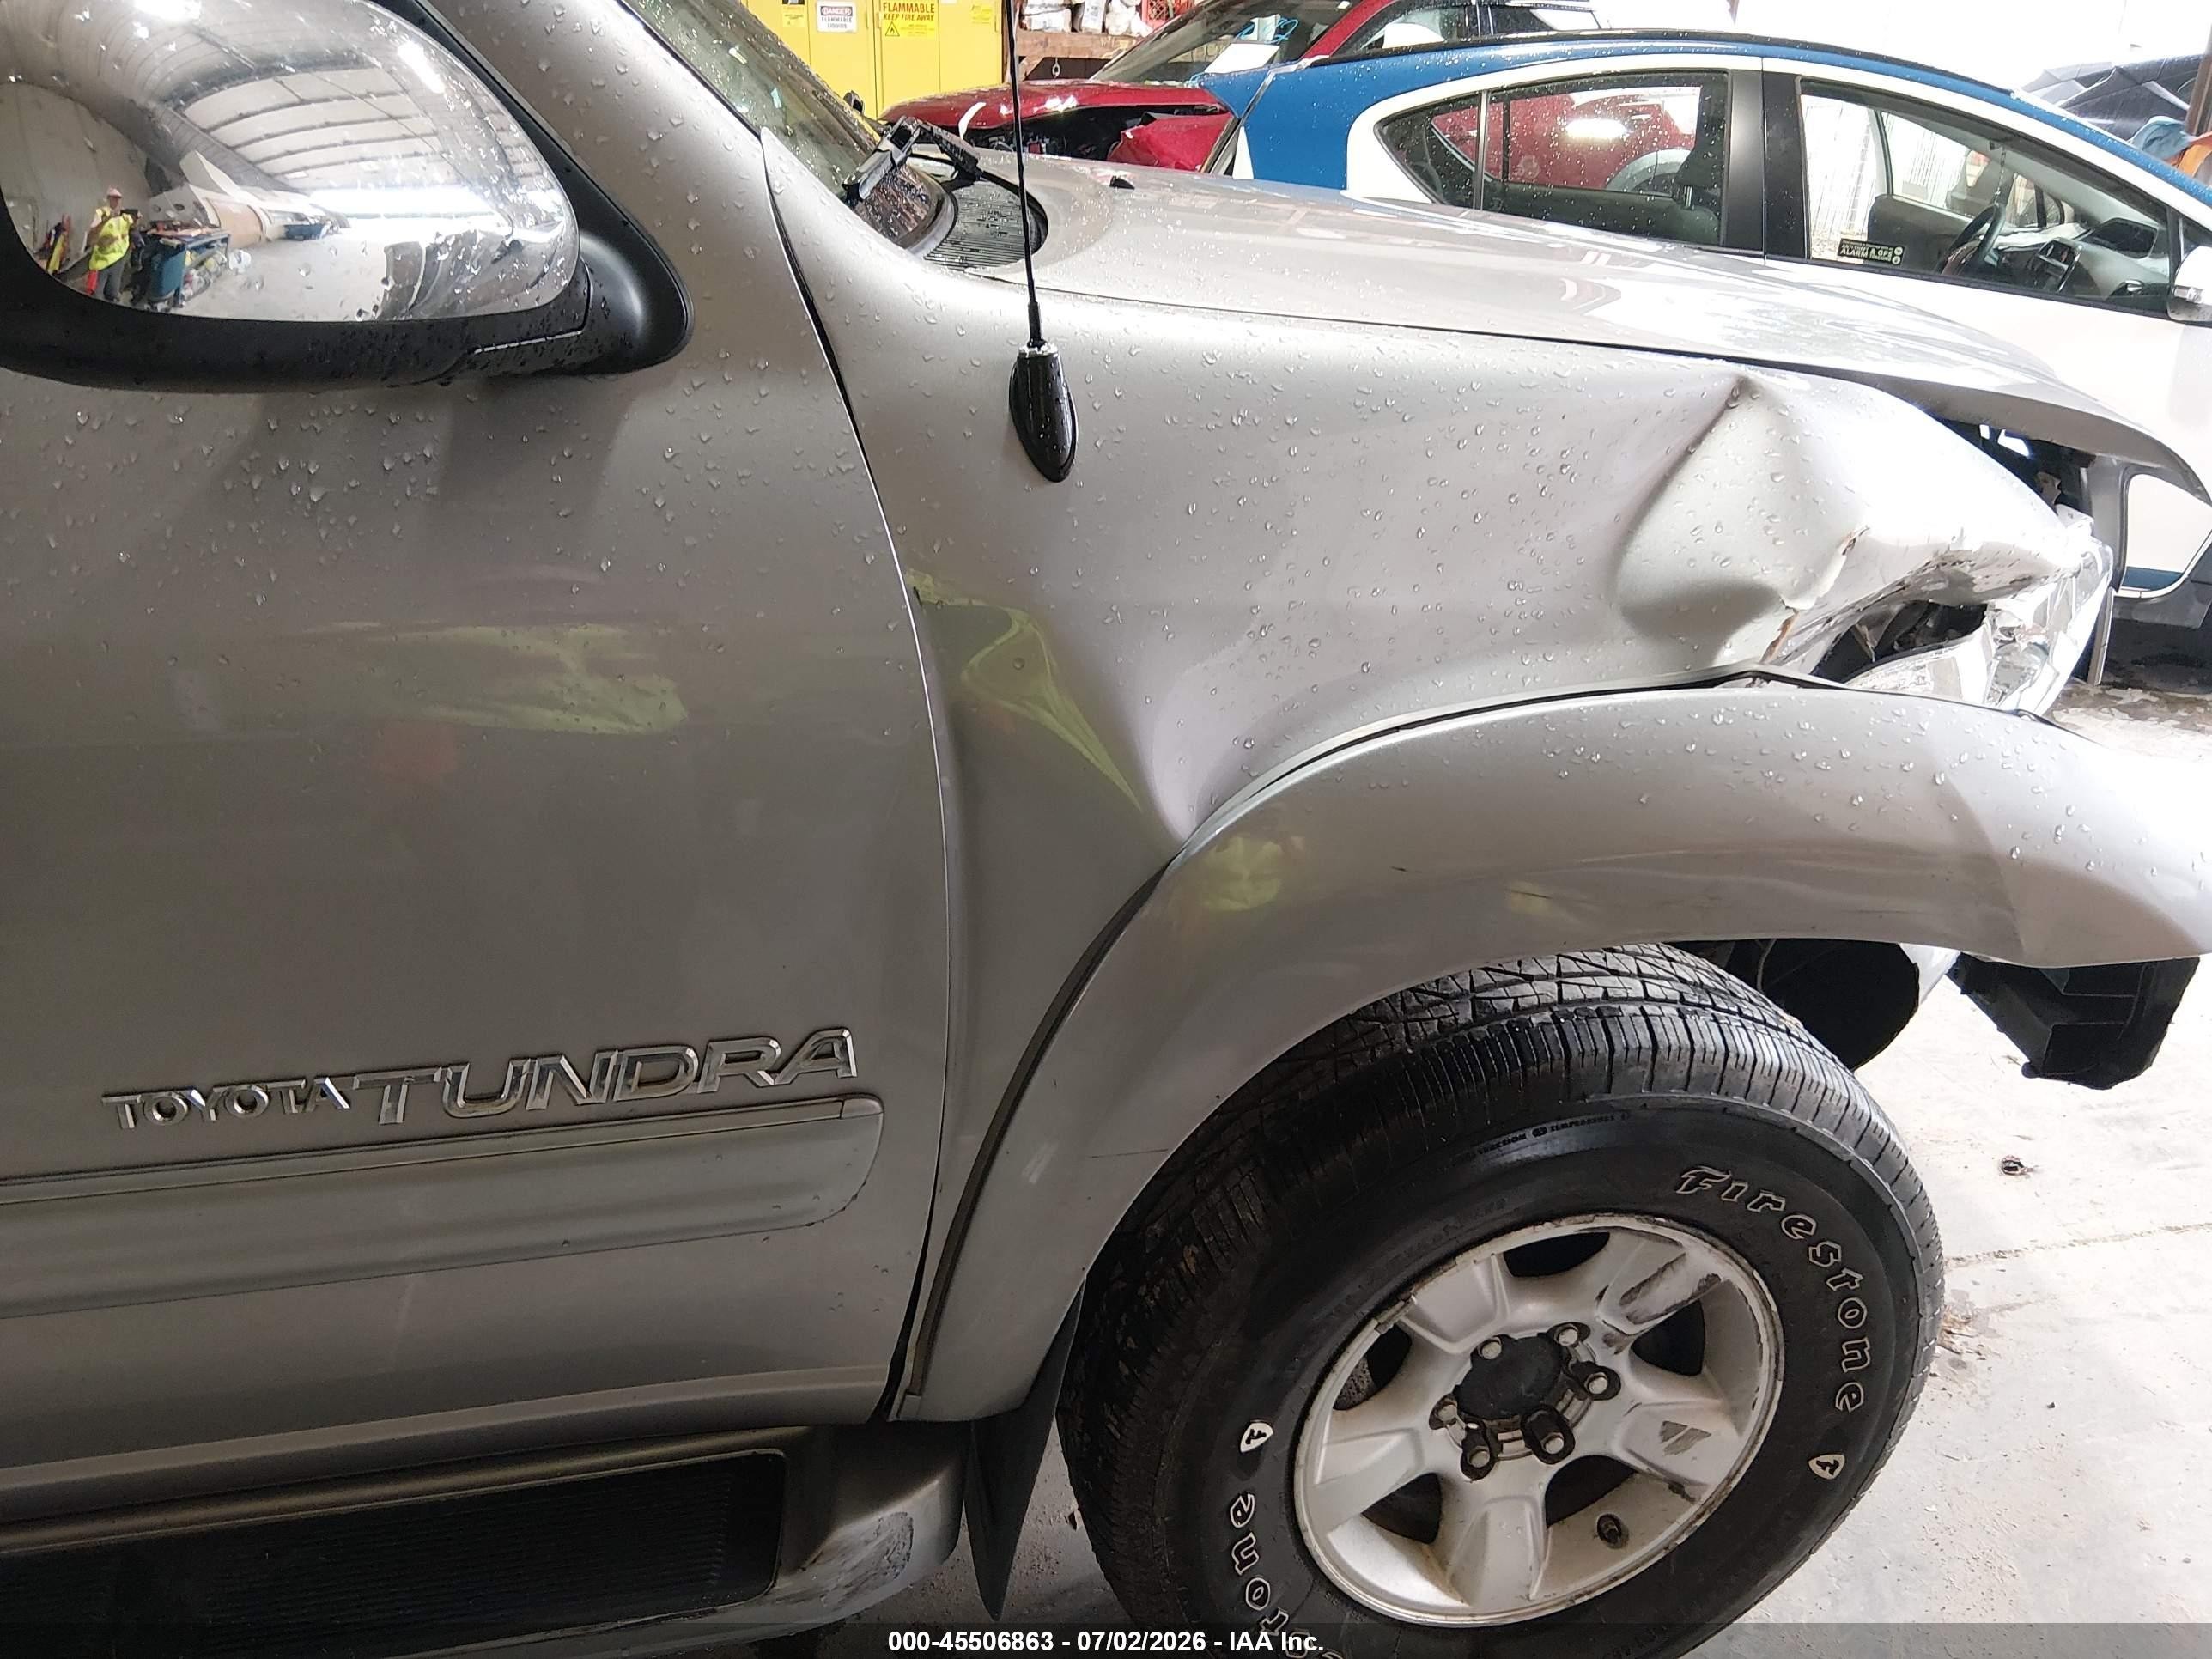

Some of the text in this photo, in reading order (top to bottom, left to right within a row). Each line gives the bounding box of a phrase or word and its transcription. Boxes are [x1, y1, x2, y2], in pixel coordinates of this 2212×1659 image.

[821, 7, 852, 15] DANGER
[883, 2, 935, 13] FLAMMABLE
[1840, 247, 1869, 258] ALARM
[101, 1028, 857, 1130] TOYOTA TUNDRA
[1675, 1164, 1872, 1413] Firestone
